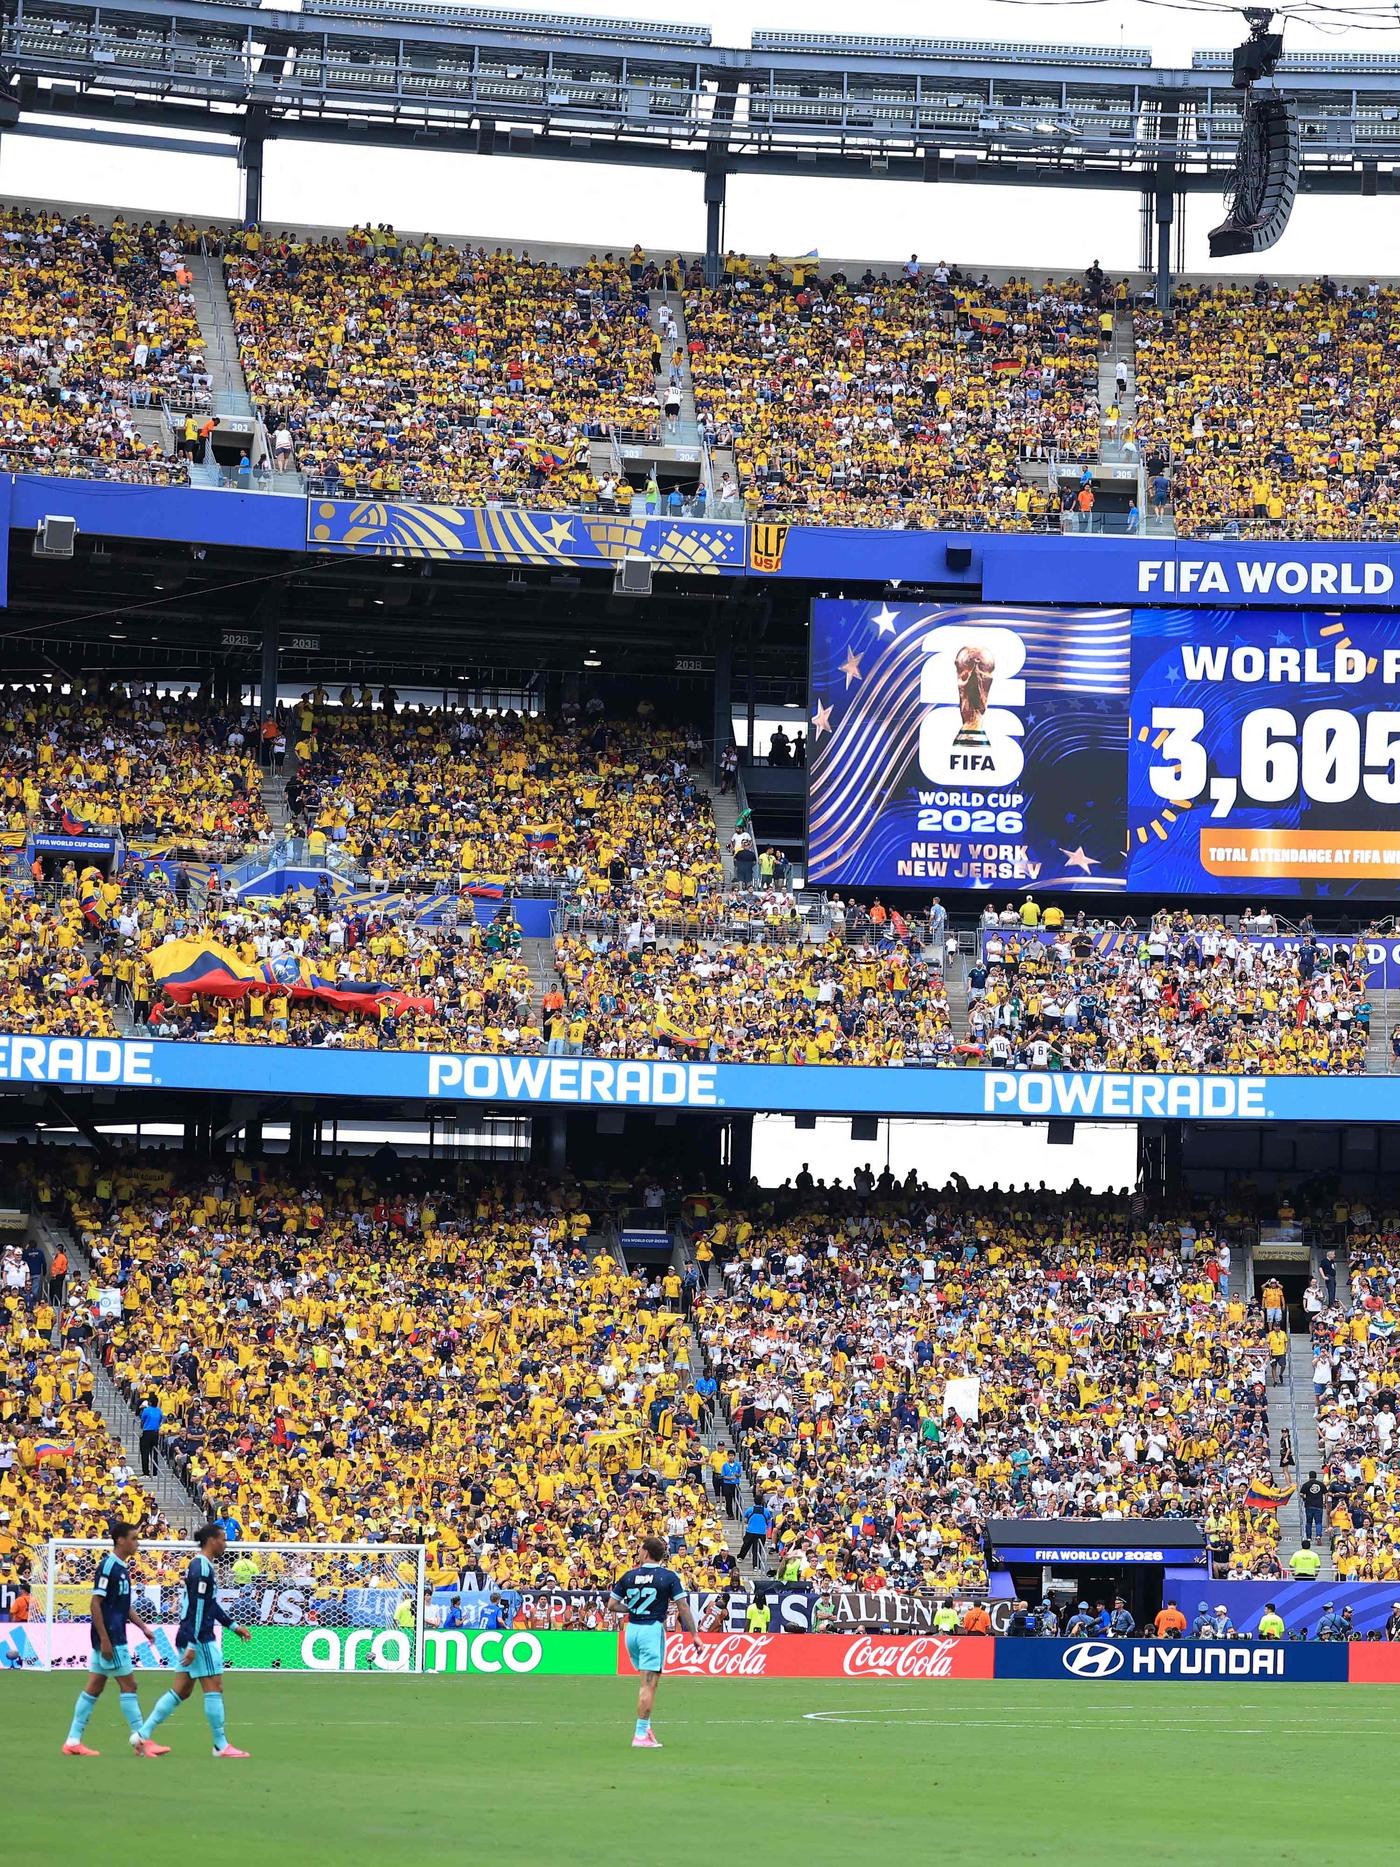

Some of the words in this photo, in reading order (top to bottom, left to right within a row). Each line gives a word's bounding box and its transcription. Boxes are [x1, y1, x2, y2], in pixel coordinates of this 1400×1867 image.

[232, 423, 248, 432] 303
[624, 450, 639, 458] 303
[1137, 560, 1231, 593] FIFA
[1236, 561, 1395, 595] WORLD
[1180, 645, 1367, 684] WORLD
[949, 753, 996, 772] FIFA
[918, 791, 985, 808] WORLD
[987, 793, 1024, 809] CUP
[917, 810, 1024, 834] 2026
[911, 842, 962, 860] NEW
[968, 843, 1029, 861] YORK
[1209, 847, 1248, 862] TOTAL
[1250, 848, 1333, 863] ATTENDANCE
[1334, 849, 1352, 863] AT
[1353, 849, 1381, 864] FIFA
[897, 860, 948, 878] NEW
[954, 861, 1042, 880] JERSEY
[0, 1037, 154, 1084] RADE
[1035, 1550, 1059, 1561] FIFA
[1060, 1550, 1099, 1561] WORLD
[1100, 1550, 1123, 1561] CUP
[1124, 1551, 1163, 1561] 2026
[626, 1587, 658, 1615] 22
[301, 1628, 543, 1673] aramco
[662, 1633, 775, 1675] Coca-Cola
[843, 1635, 960, 1677] Coca-Cola
[1132, 1647, 1285, 1675] HYUNDAI
